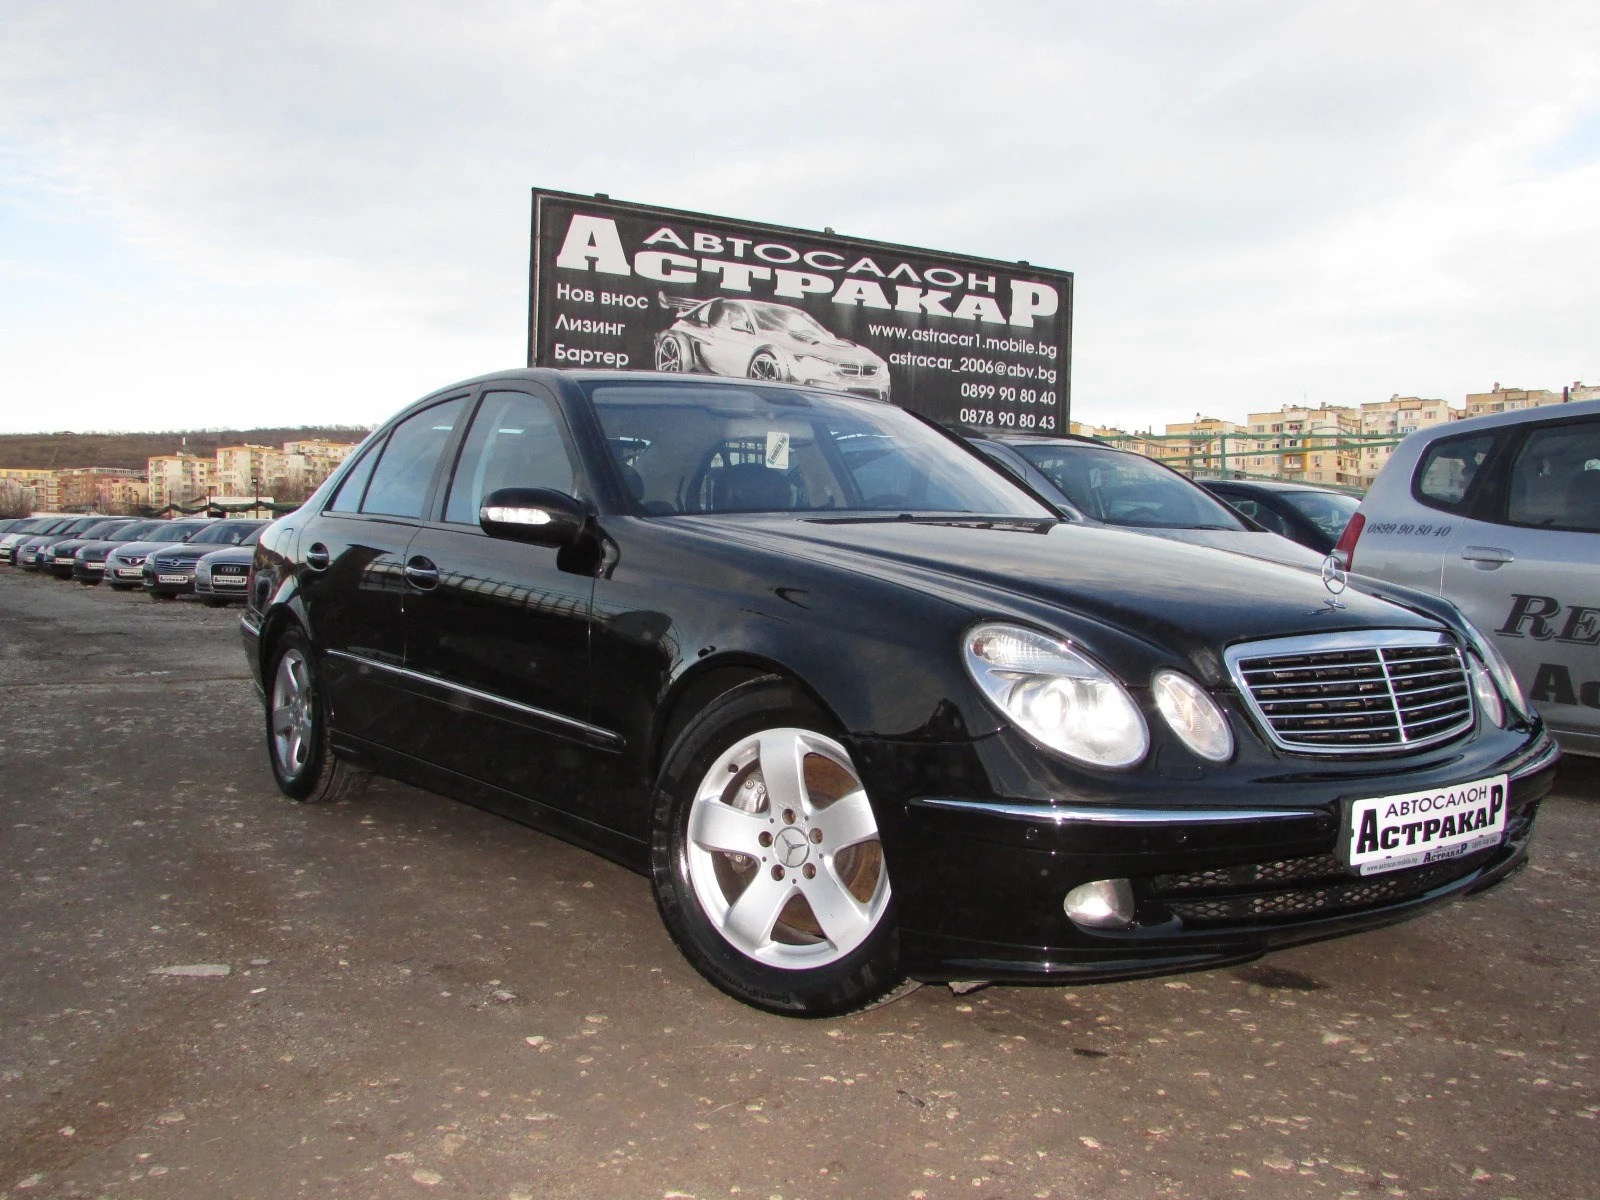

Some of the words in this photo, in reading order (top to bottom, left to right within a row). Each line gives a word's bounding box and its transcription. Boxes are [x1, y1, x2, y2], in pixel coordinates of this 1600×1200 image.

[643, 227, 995, 292] АВТОСАЛОН
[557, 283, 595, 303] Нов
[555, 313, 625, 335] Лизинг
[868, 324, 1057, 358] www.astracar1.mobile.bg
[554, 343, 629, 368] Бартер
[889, 352, 1057, 383] astracar_2006@abv.bg
[960, 383, 995, 399] 0899
[999, 386, 1016, 401] 90
[1019, 389, 1036, 403] 80
[1039, 391, 1056, 405] 40
[960, 408, 994, 424] 0878
[998, 411, 1015, 426] 90
[1019, 413, 1036, 428] 80
[1039, 415, 1055, 429] 43
[1367, 523, 1397, 534] 0899
[1397, 524, 1415, 535] 90
[1415, 525, 1433, 536] 80
[1433, 526, 1452, 537] 40
[1385, 785, 1488, 819] АВТОСАЛОН
